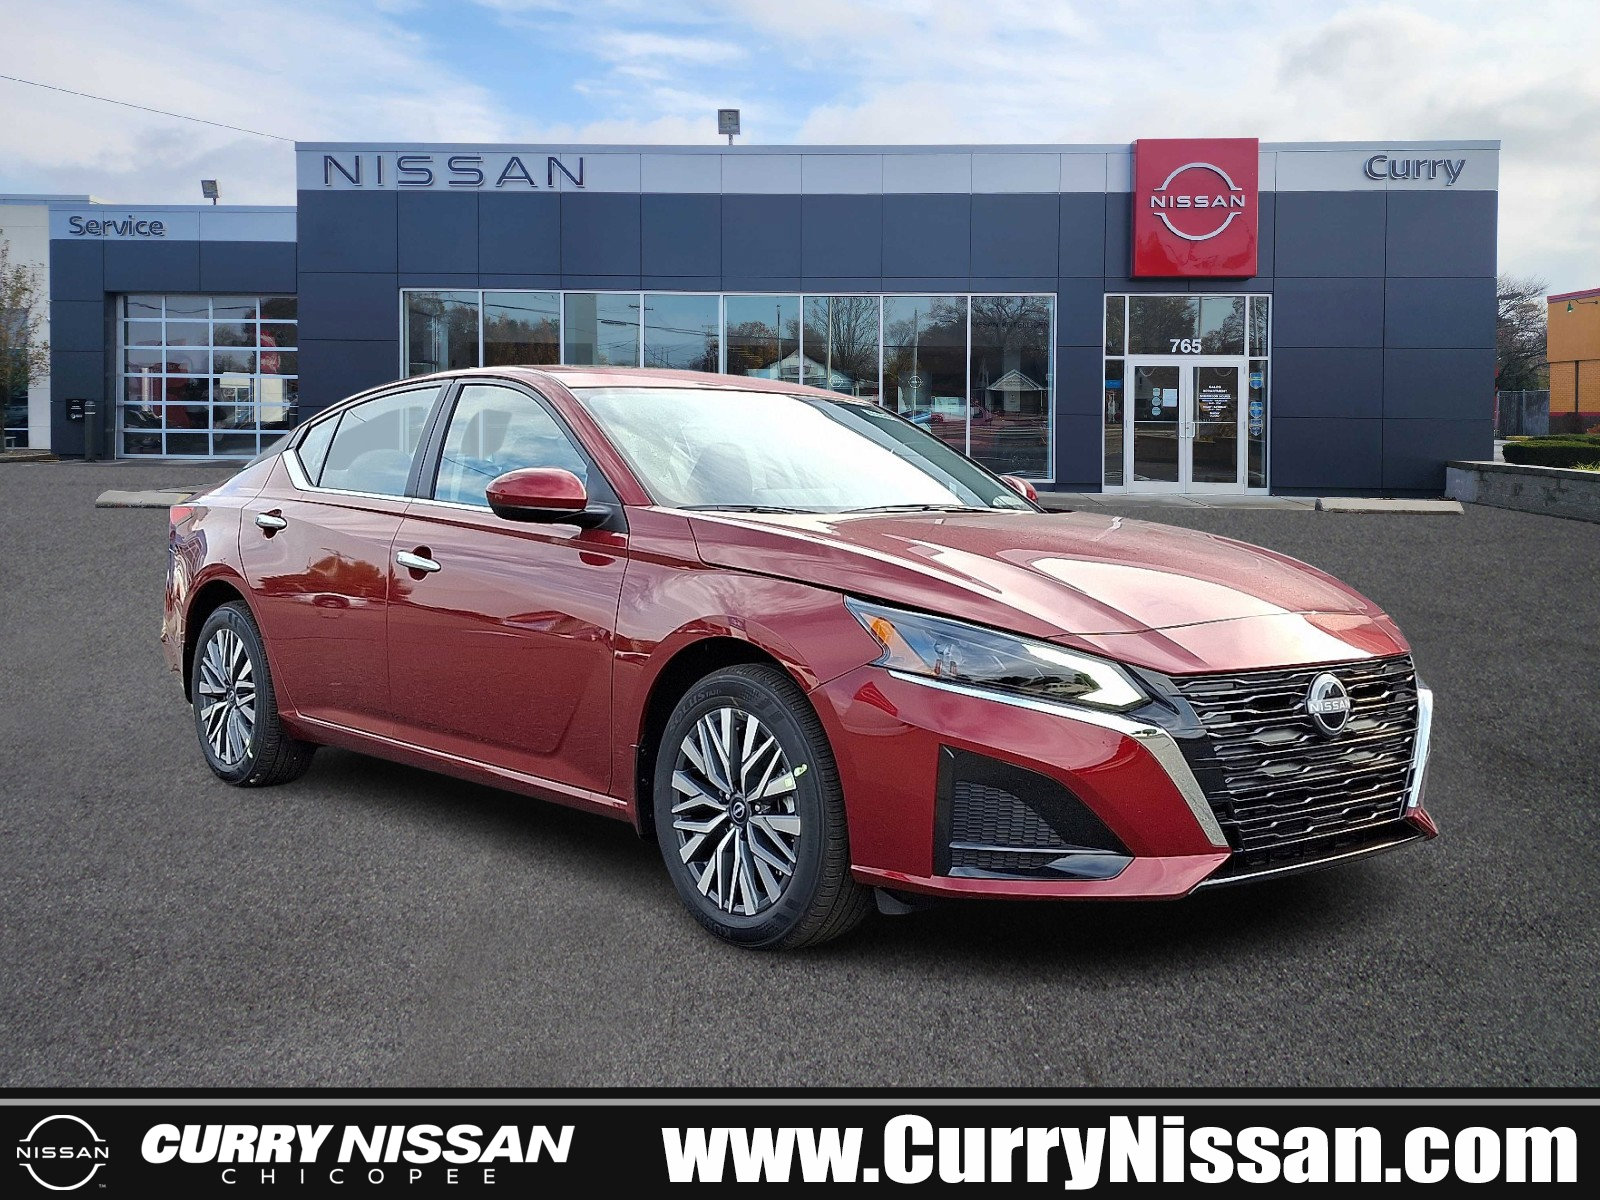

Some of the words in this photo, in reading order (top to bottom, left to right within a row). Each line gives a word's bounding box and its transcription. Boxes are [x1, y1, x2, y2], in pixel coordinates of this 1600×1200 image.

[323, 155, 585, 188] NISSAN
[1364, 154, 1466, 187] Curry
[1150, 194, 1245, 208] NISSAN
[69, 214, 165, 237] Service
[1169, 338, 1202, 354] 765
[1309, 698, 1351, 713] NISSAN
